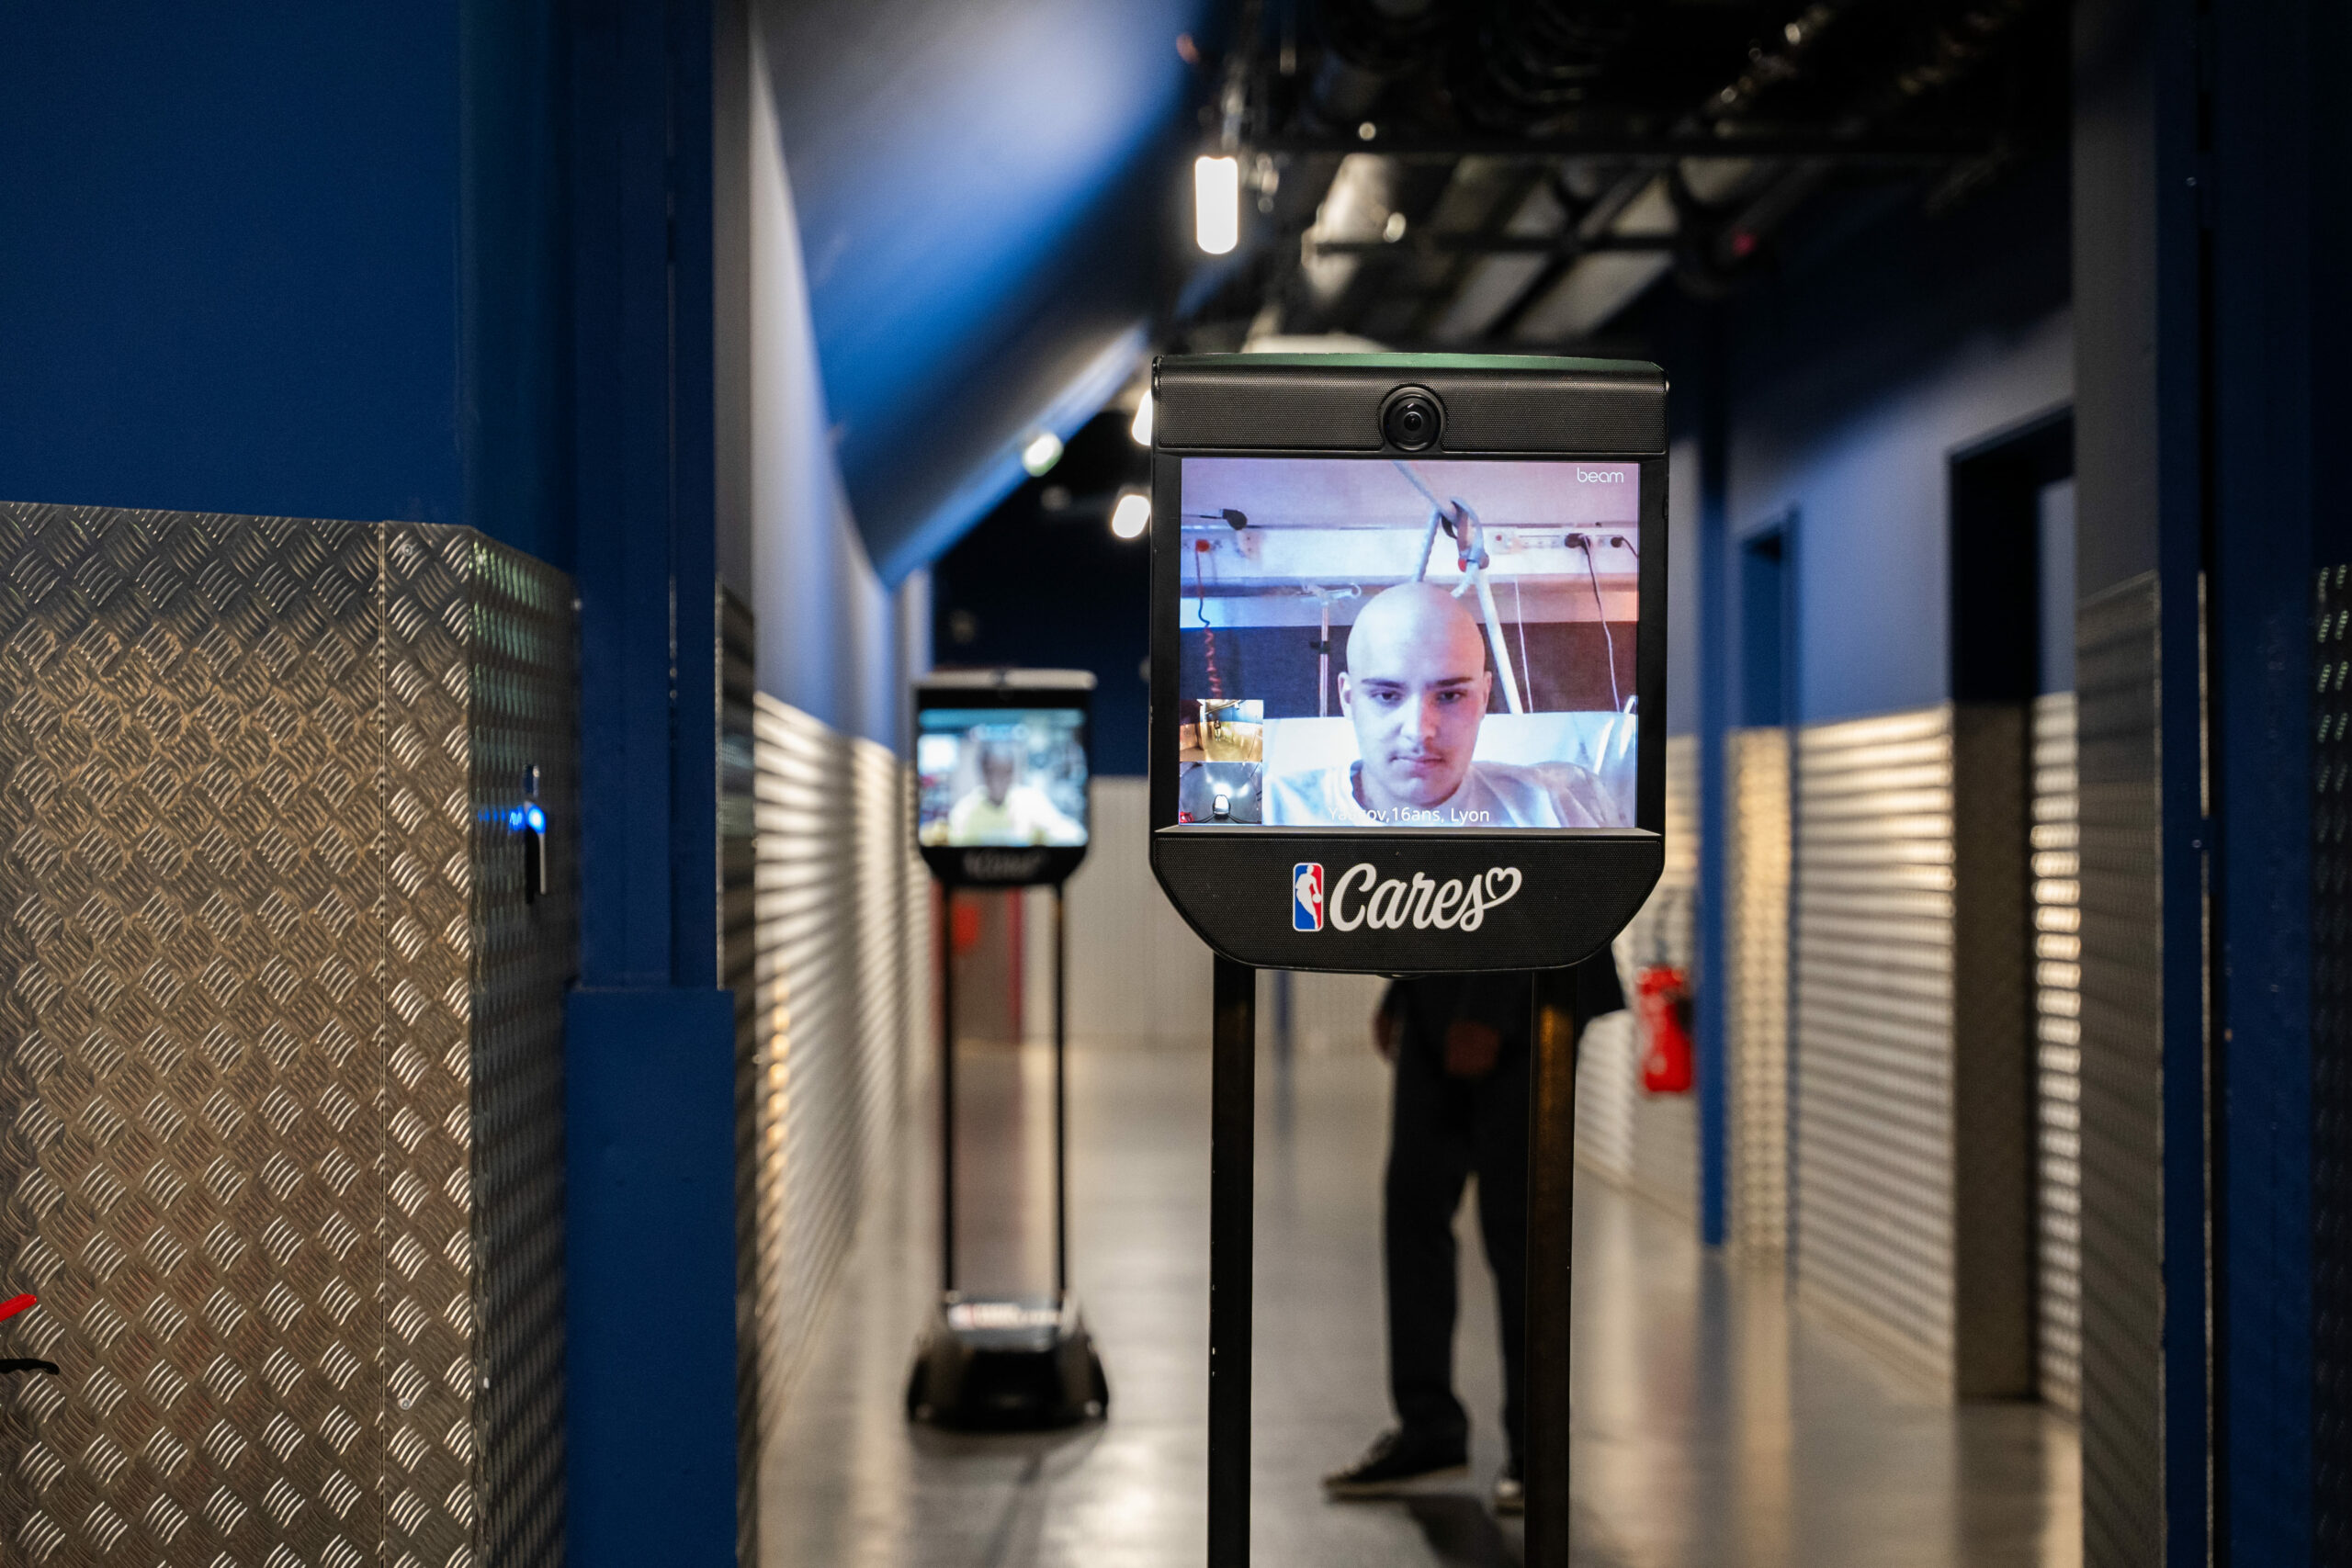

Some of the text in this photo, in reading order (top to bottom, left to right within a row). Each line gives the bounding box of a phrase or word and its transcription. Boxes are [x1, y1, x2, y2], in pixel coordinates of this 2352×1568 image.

[1577, 467, 1624, 483] beam
[1451, 807, 1490, 826] Lyon
[1329, 863, 1486, 932] Cares
